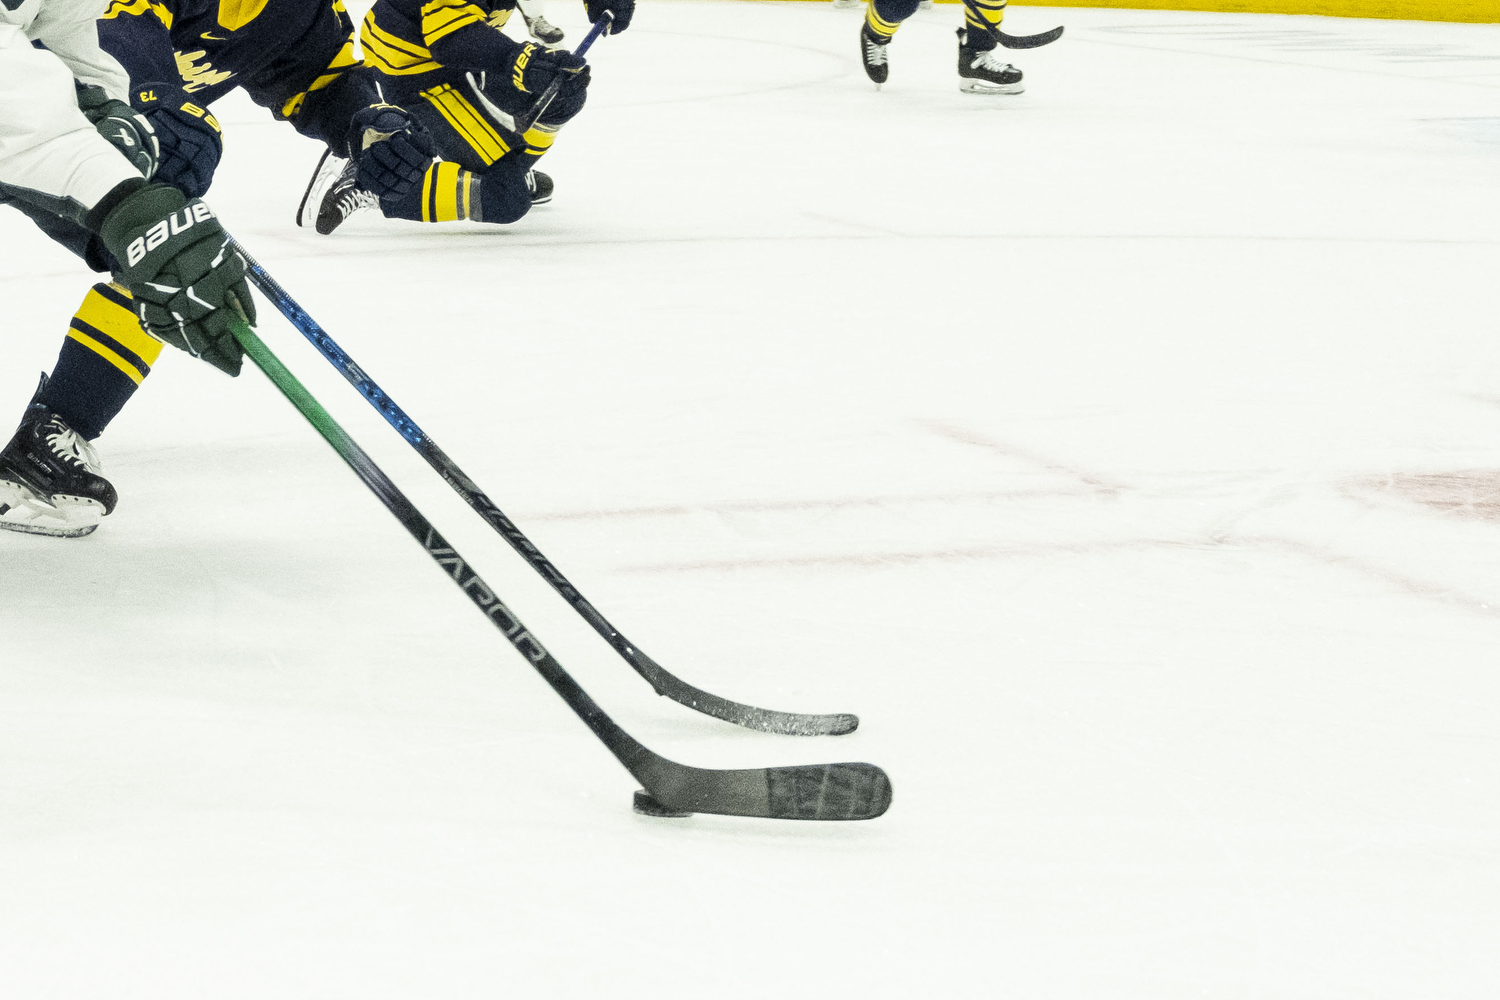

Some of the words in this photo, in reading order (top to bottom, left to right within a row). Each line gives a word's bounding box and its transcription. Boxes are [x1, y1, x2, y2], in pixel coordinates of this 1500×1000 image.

[512, 43, 538, 94] AUER
[126, 201, 216, 268] BAUE
[426, 528, 547, 665] VAPOR
